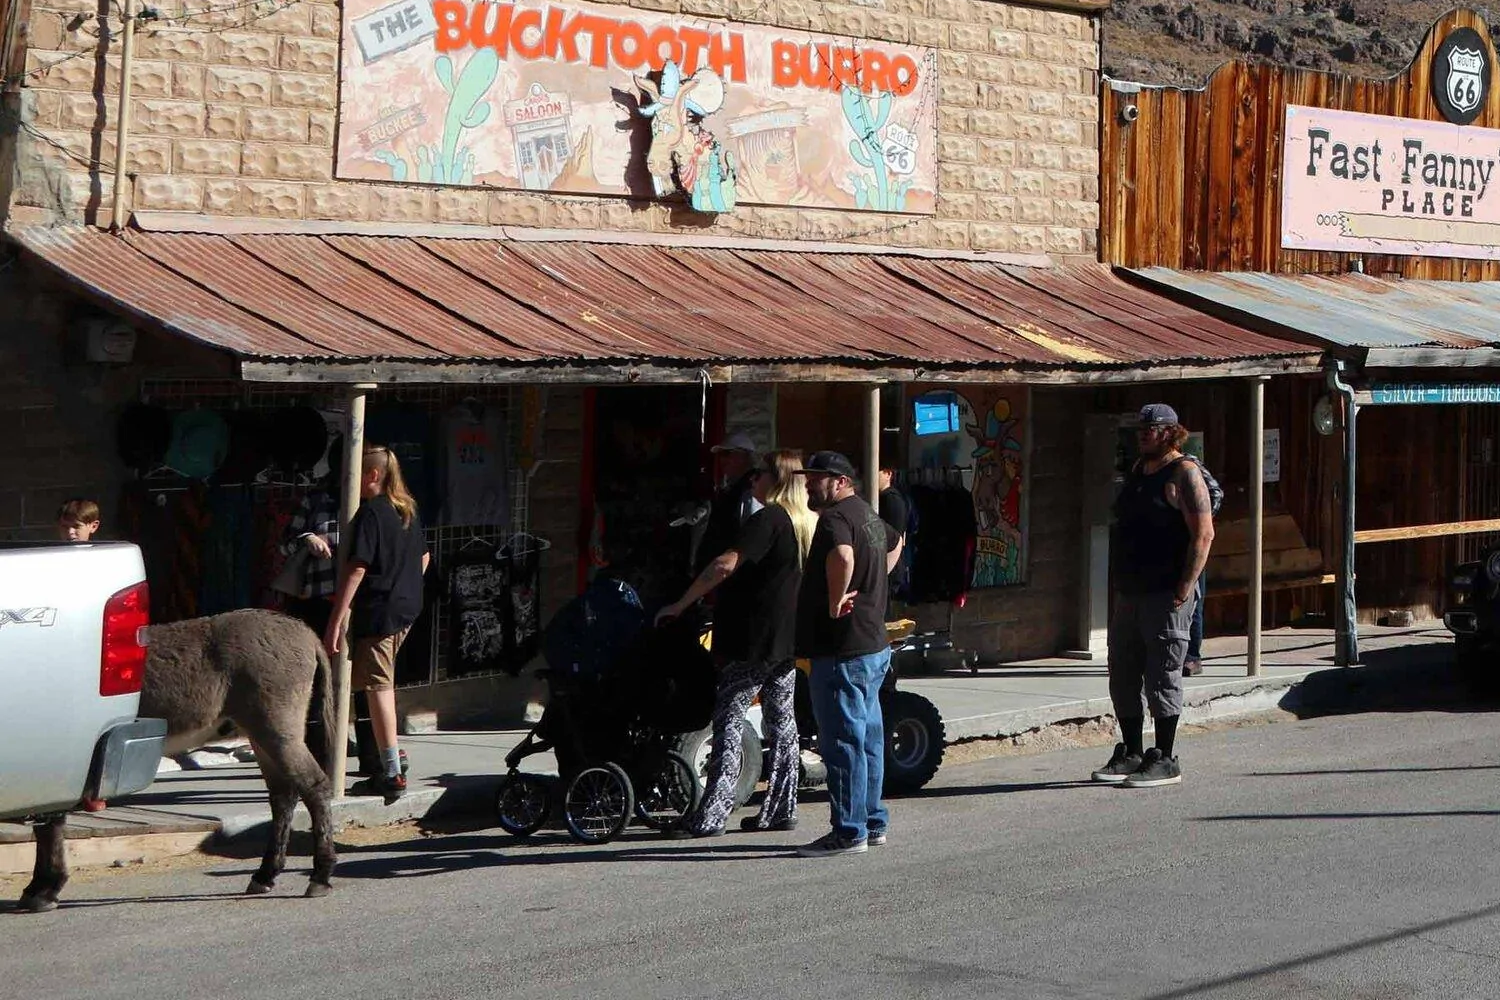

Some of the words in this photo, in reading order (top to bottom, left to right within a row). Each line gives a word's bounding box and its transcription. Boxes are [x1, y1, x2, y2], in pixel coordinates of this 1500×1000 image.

[369, 5, 424, 44] THE
[771, 39, 920, 97] BURRO
[1454, 77, 1475, 104] 66
[515, 101, 562, 121] SALOON
[886, 145, 908, 170] 66
[1307, 128, 1382, 182] Fast
[1381, 189, 1473, 217] PLACE
[1383, 383, 1424, 403] SILVER
